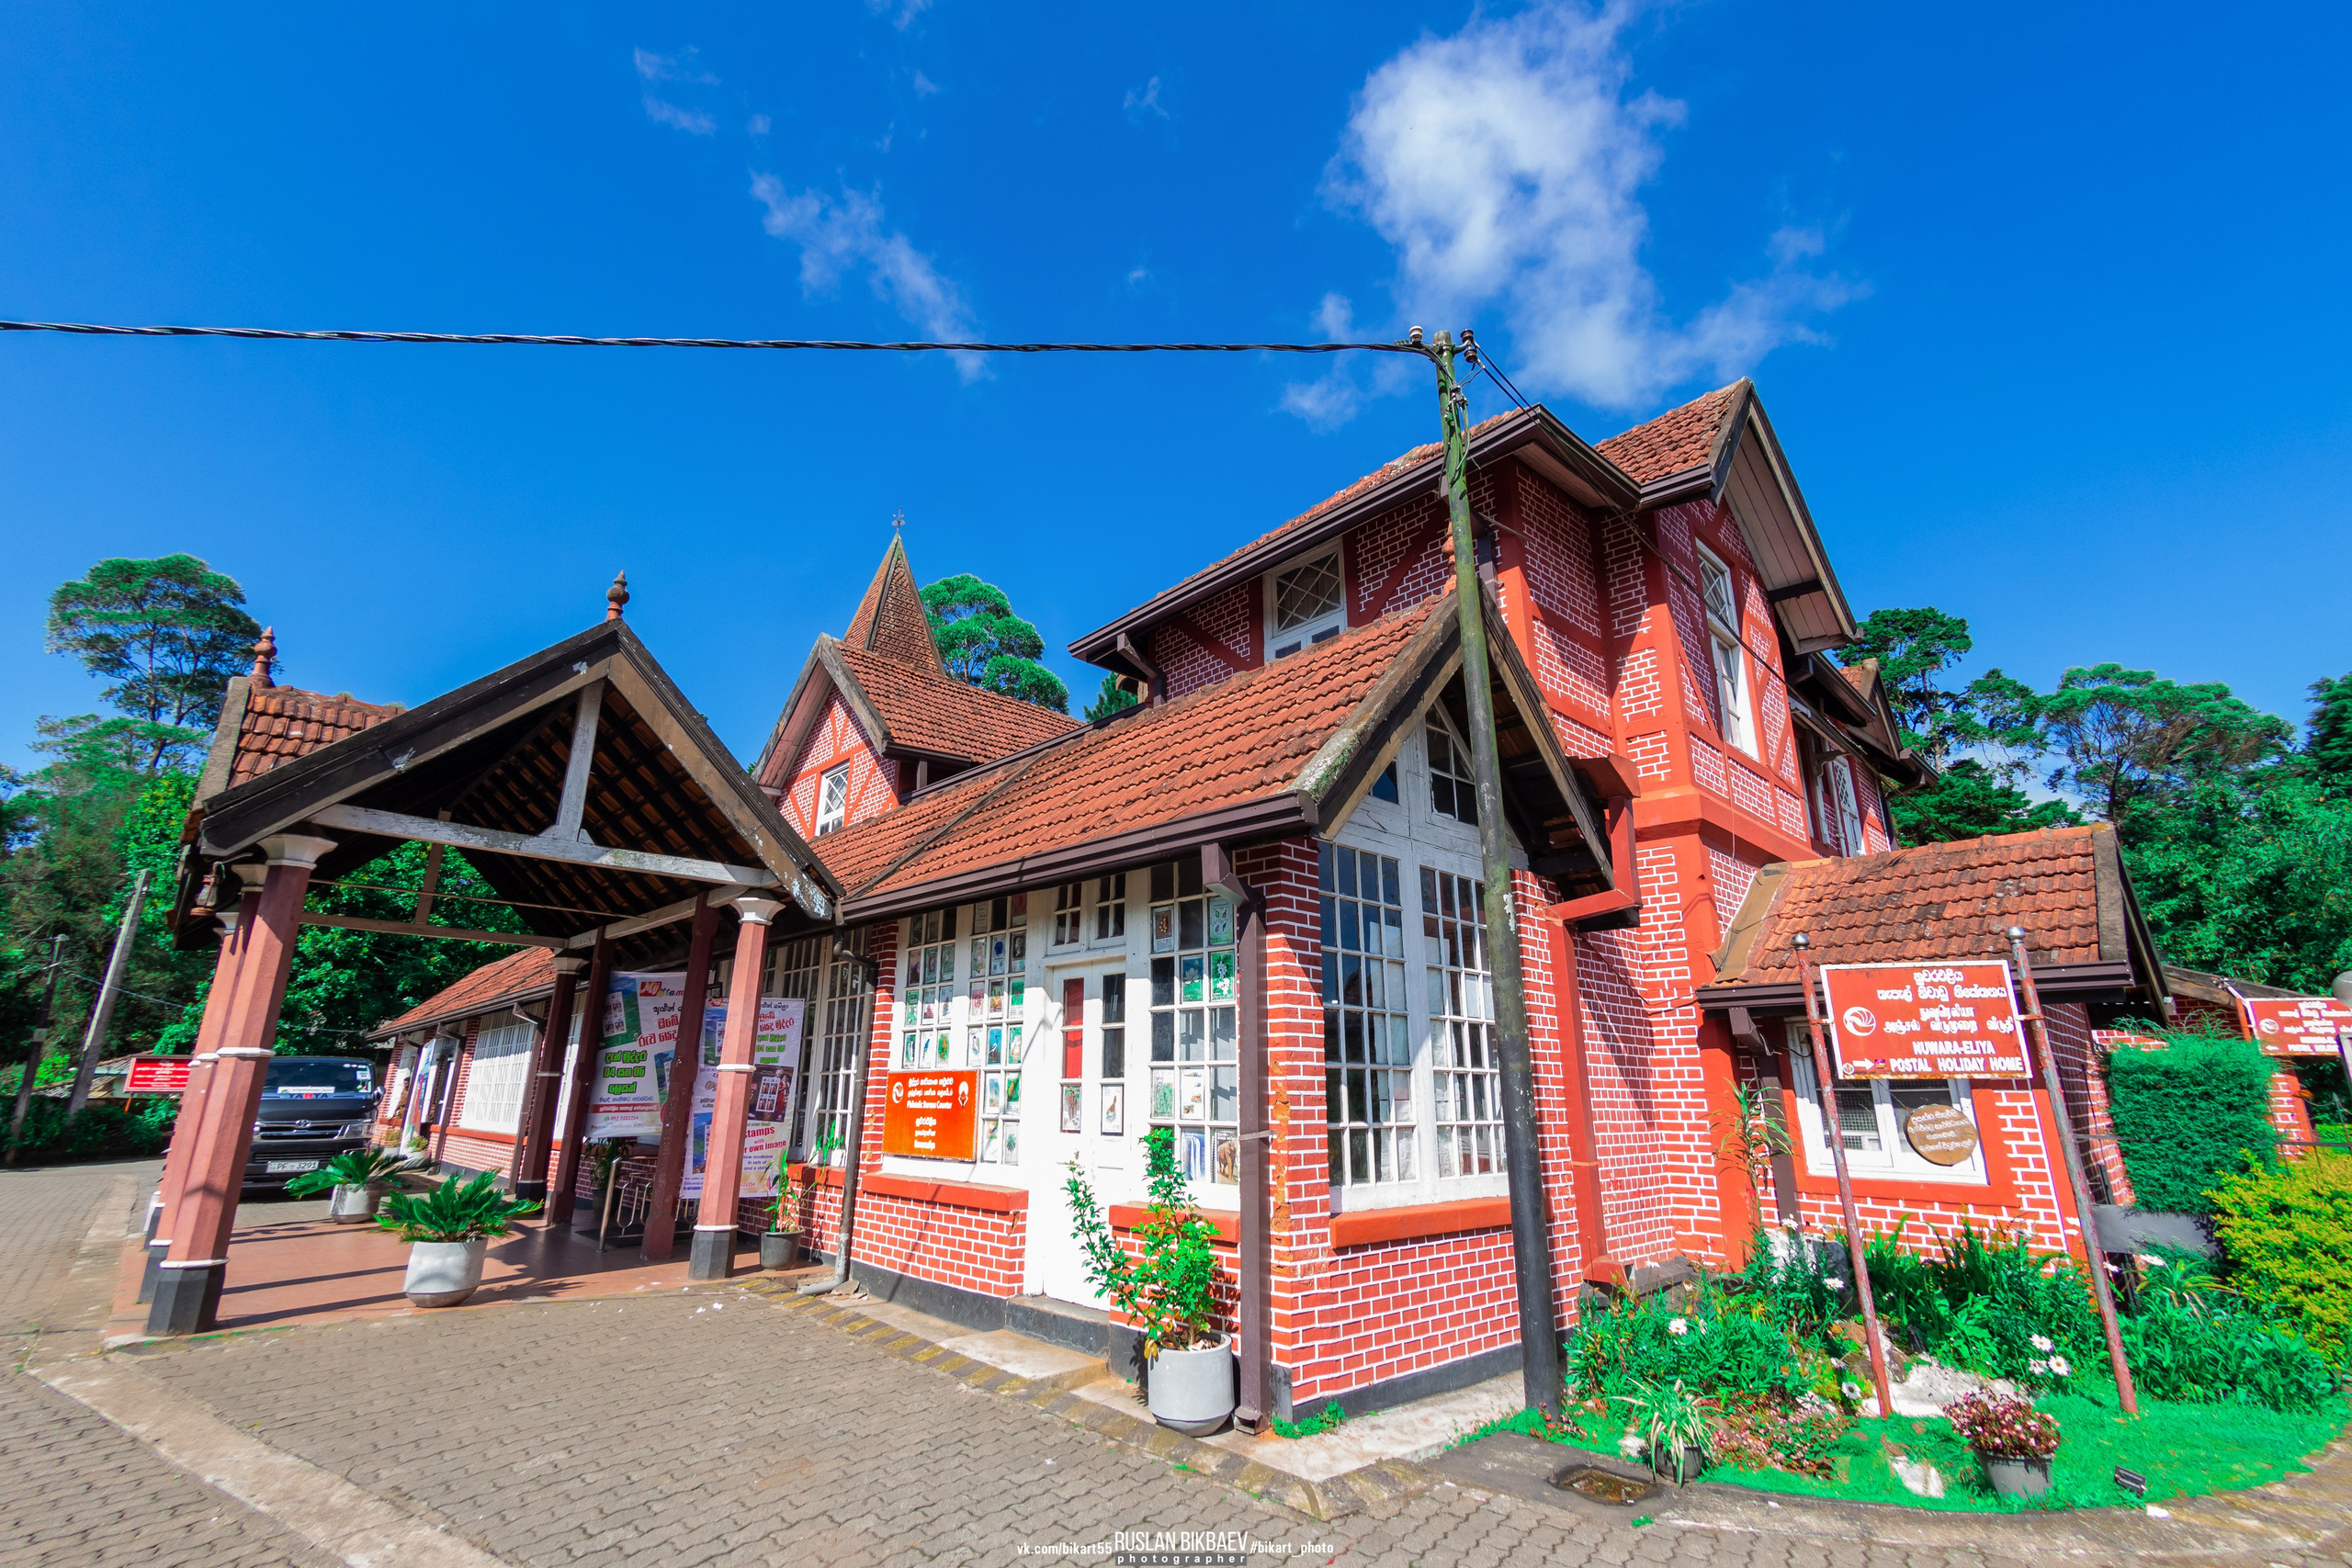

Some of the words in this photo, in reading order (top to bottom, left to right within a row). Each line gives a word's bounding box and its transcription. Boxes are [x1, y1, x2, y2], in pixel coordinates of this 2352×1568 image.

[1912, 1040, 1996, 1055] NUWARA-ELIYA
[1889, 1058, 1932, 1072] POSTAL
[1937, 1057, 1985, 1072] HOLIDAY
[1989, 1056, 2024, 1071] HOME
[603, 1066, 616, 1077] 04
[749, 1144, 763, 1153] own
[764, 1140, 787, 1150] image
[297, 1161, 317, 1169] 3291
